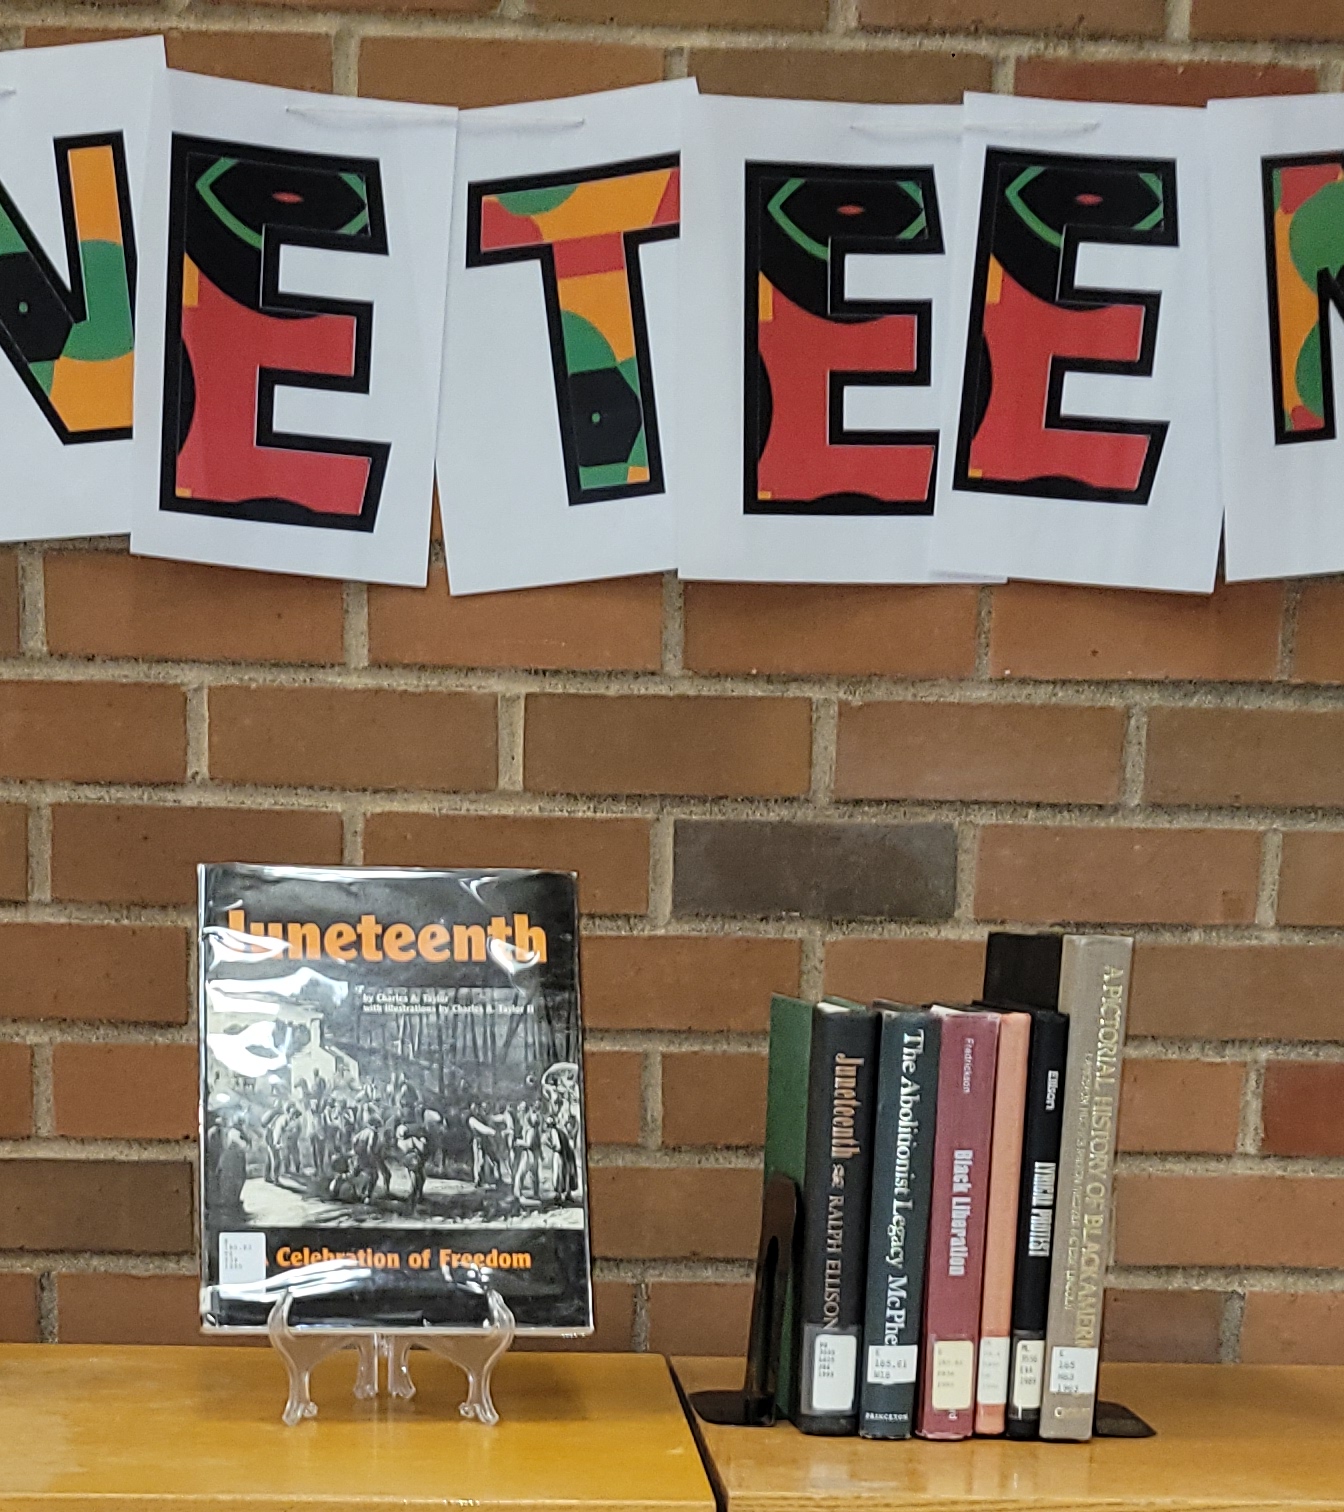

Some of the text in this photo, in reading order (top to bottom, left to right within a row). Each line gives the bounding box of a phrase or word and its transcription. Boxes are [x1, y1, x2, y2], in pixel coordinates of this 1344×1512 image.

[830, 1052, 865, 1158] Juneteenth
[962, 1037, 975, 1094] Fredrickson
[885, 1029, 925, 1269] The Abolitionist Legacy
[1078, 965, 1123, 1281] A PICTORIAL HISTORY OF BLACK
[826, 1195, 844, 1253] RALPH
[948, 1149, 974, 1277] Black Liberation
[1028, 1161, 1056, 1257] LYRICAL PROTEST
[276, 1247, 400, 1269] Celebration
[409, 1247, 432, 1269] of
[440, 1249, 531, 1269] Freedom
[822, 1259, 842, 1330] ELLISON
